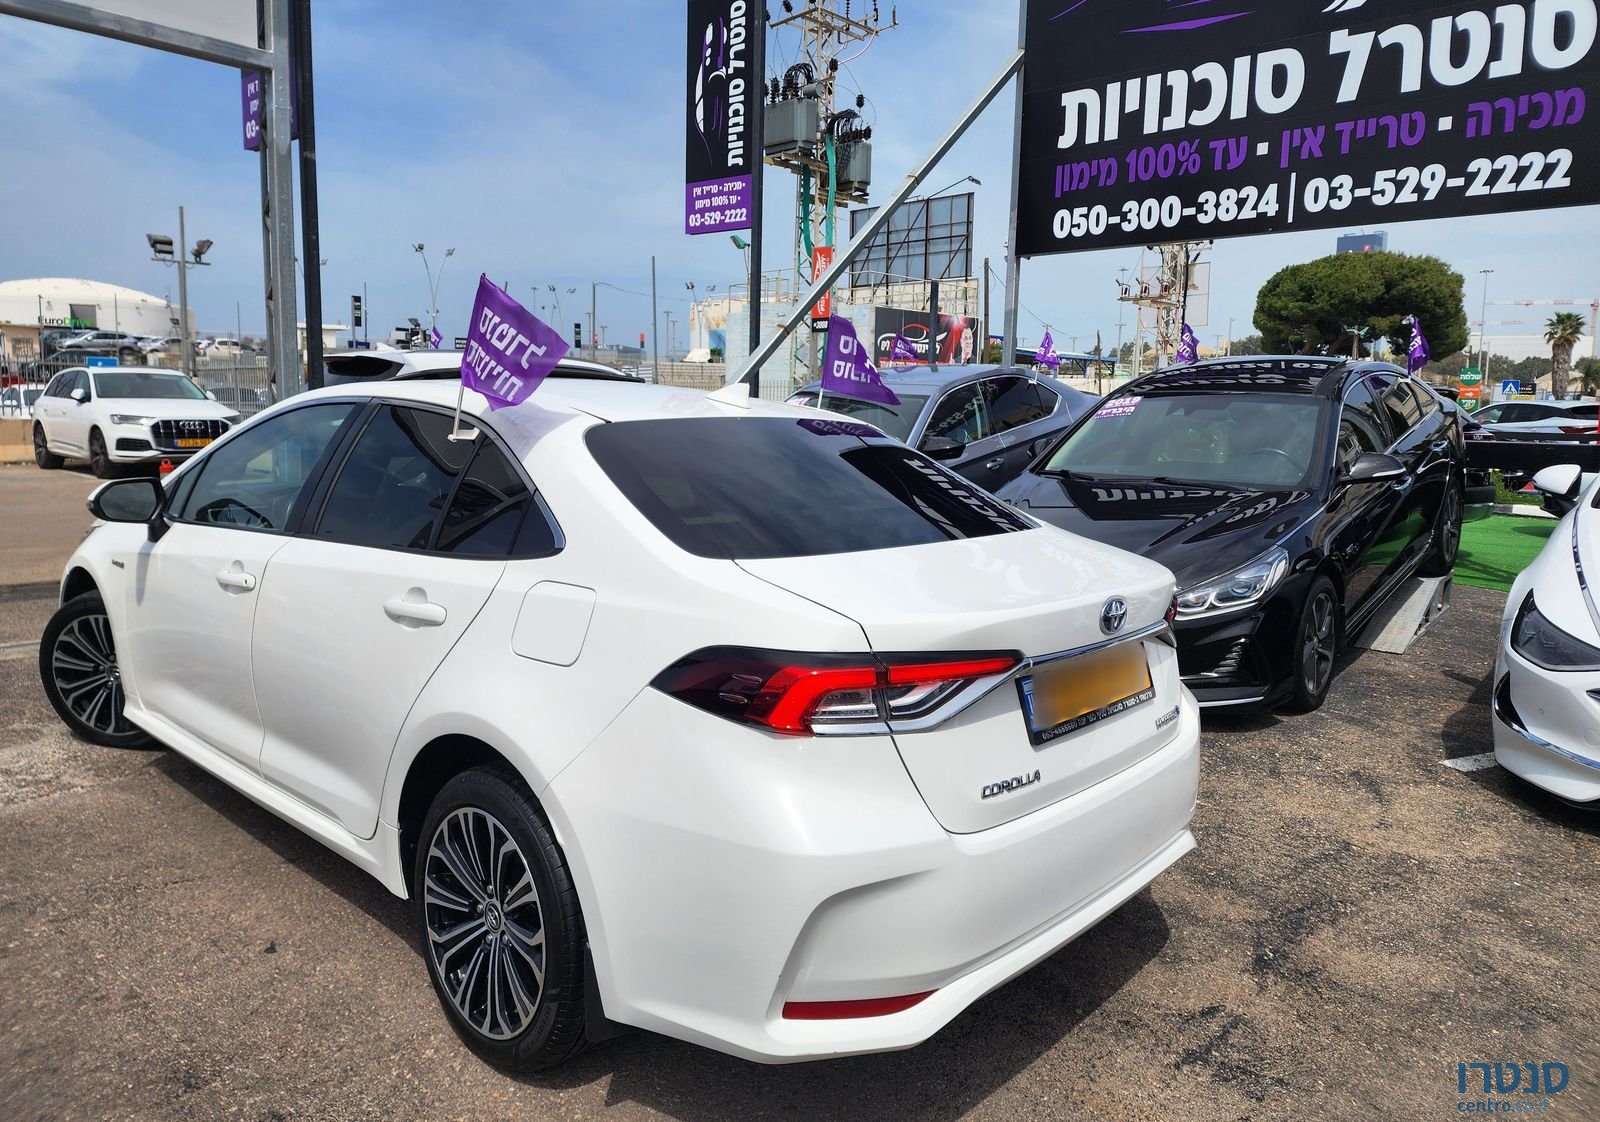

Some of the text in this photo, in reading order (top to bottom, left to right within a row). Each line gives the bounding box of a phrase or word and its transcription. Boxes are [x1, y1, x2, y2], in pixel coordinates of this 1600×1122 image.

[1057, 0, 1599, 149] סנטרל סוכנויות
[728, 78, 745, 167] סוכנויות
[1054, 87, 1586, 199] מכירה טרייד אין עד 100% מימון
[711, 195, 729, 206] 100%
[723, 181, 742, 193] מכירה
[1052, 148, 1573, 239] 050-300-3824 03-529-2222
[689, 208, 747, 228] 03-529-2222
[981, 768, 1041, 800] COROLLA
